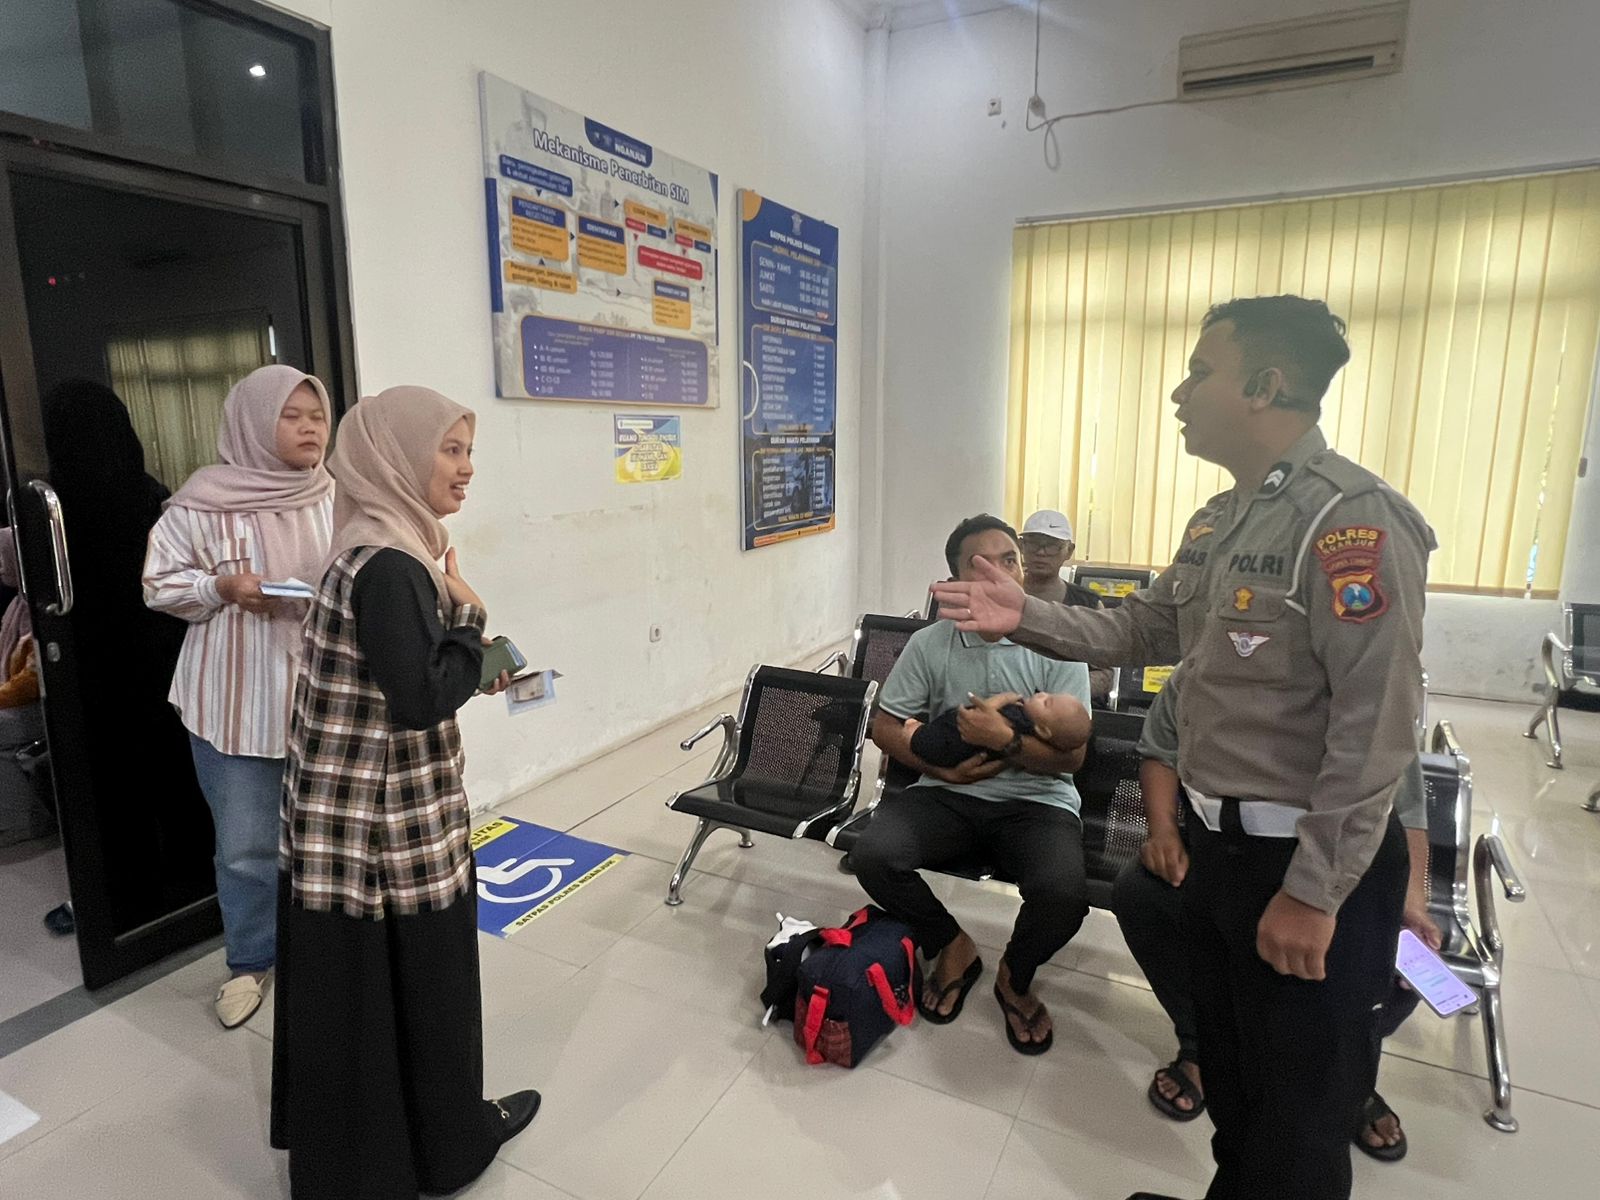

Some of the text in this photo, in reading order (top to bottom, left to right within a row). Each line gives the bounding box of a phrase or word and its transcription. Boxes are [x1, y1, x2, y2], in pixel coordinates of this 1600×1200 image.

[615, 143, 647, 163] NGANJUK
[533, 128, 608, 174] Mekanisme
[610, 158, 669, 197] Penerbitan
[670, 183, 690, 204] SIM
[1317, 528, 1377, 550] POLRES
[1322, 540, 1376, 555] NGANJUK
[1228, 554, 1284, 576] POLRI
[515, 859, 616, 926] SATPAS POLRES NGANJUK
